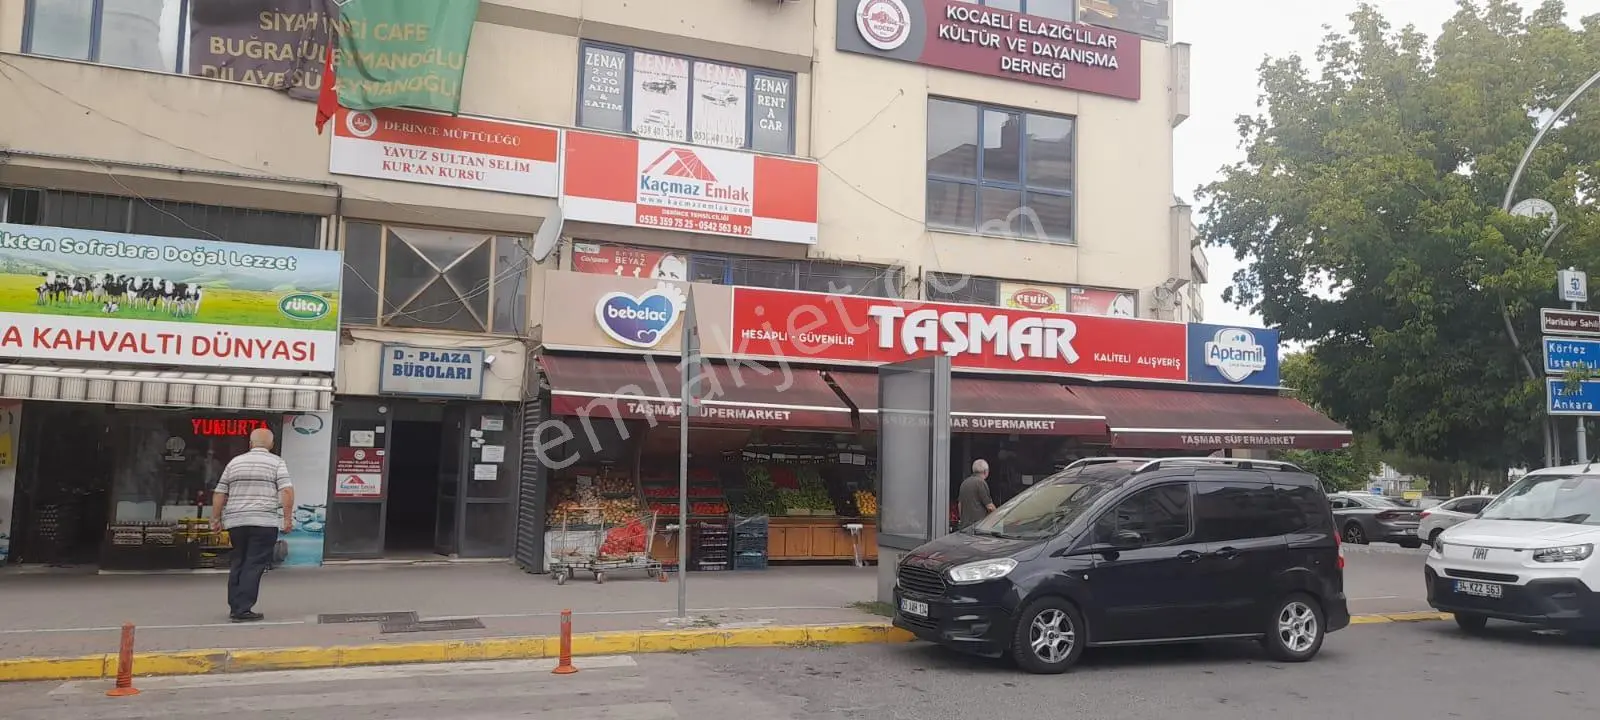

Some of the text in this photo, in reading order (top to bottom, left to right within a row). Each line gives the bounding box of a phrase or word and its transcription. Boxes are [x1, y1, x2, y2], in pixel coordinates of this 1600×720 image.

[259, 8, 318, 32] SİYAH
[373, 22, 429, 41] CAFE
[946, 4, 1118, 49] KOCAELİ ELAZIĞ'LILAR
[209, 35, 294, 61] BUĞRA
[939, 23, 1119, 70] KÜLTÜR VE DAYANIŞMA
[586, 53, 624, 69] ZENAY
[1001, 56, 1066, 80] DERNEĞİ
[589, 84, 620, 94] ALIM
[592, 77, 618, 85] OTO
[754, 78, 788, 95] ZENAY
[585, 100, 622, 111] SATIM
[758, 95, 785, 108] RENT
[767, 108, 775, 119] A
[384, 120, 521, 146] DERİNCE MÜFTÜLÜĞÜ
[760, 119, 783, 131] CAR
[383, 146, 530, 173] YAVUZ SULTAN SELİM
[382, 160, 486, 181] KUR'AN KURSU
[640, 175, 750, 202] Kaçmaz Emlak
[639, 215, 658, 225] 0535
[660, 217, 673, 226] 359
[674, 219, 683, 227] 75
[684, 220, 694, 228] 25
[699, 221, 717, 231] 0542
[718, 223, 731, 232] 563
[732, 224, 742, 233] 94
[743, 225, 752, 235] 72
[60, 237, 159, 260] Sofralara
[164, 246, 226, 268] Doğal
[230, 250, 297, 271] Lezzet
[615, 256, 646, 266] BEYAZ
[607, 305, 667, 322] bebelac
[741, 329, 788, 342] HESAPLI
[799, 332, 854, 346] GÜVENİLİR
[868, 304, 1080, 364] TAŞMAR
[33, 327, 182, 356] KAHVALTI
[192, 331, 316, 362] DÜNYASI
[1211, 344, 1262, 362] Aptamil
[1549, 342, 1586, 355] Körfez
[394, 350, 404, 360] D
[419, 351, 472, 364] PLAZA
[1094, 351, 1181, 371] KALİTELİ ALIŞVERİŞ
[392, 362, 472, 380] BÜROLARI
[1553, 399, 1593, 410] Ankara
[971, 417, 1056, 431] SÜPERMARKET
[1472, 548, 1489, 560] FIAT
